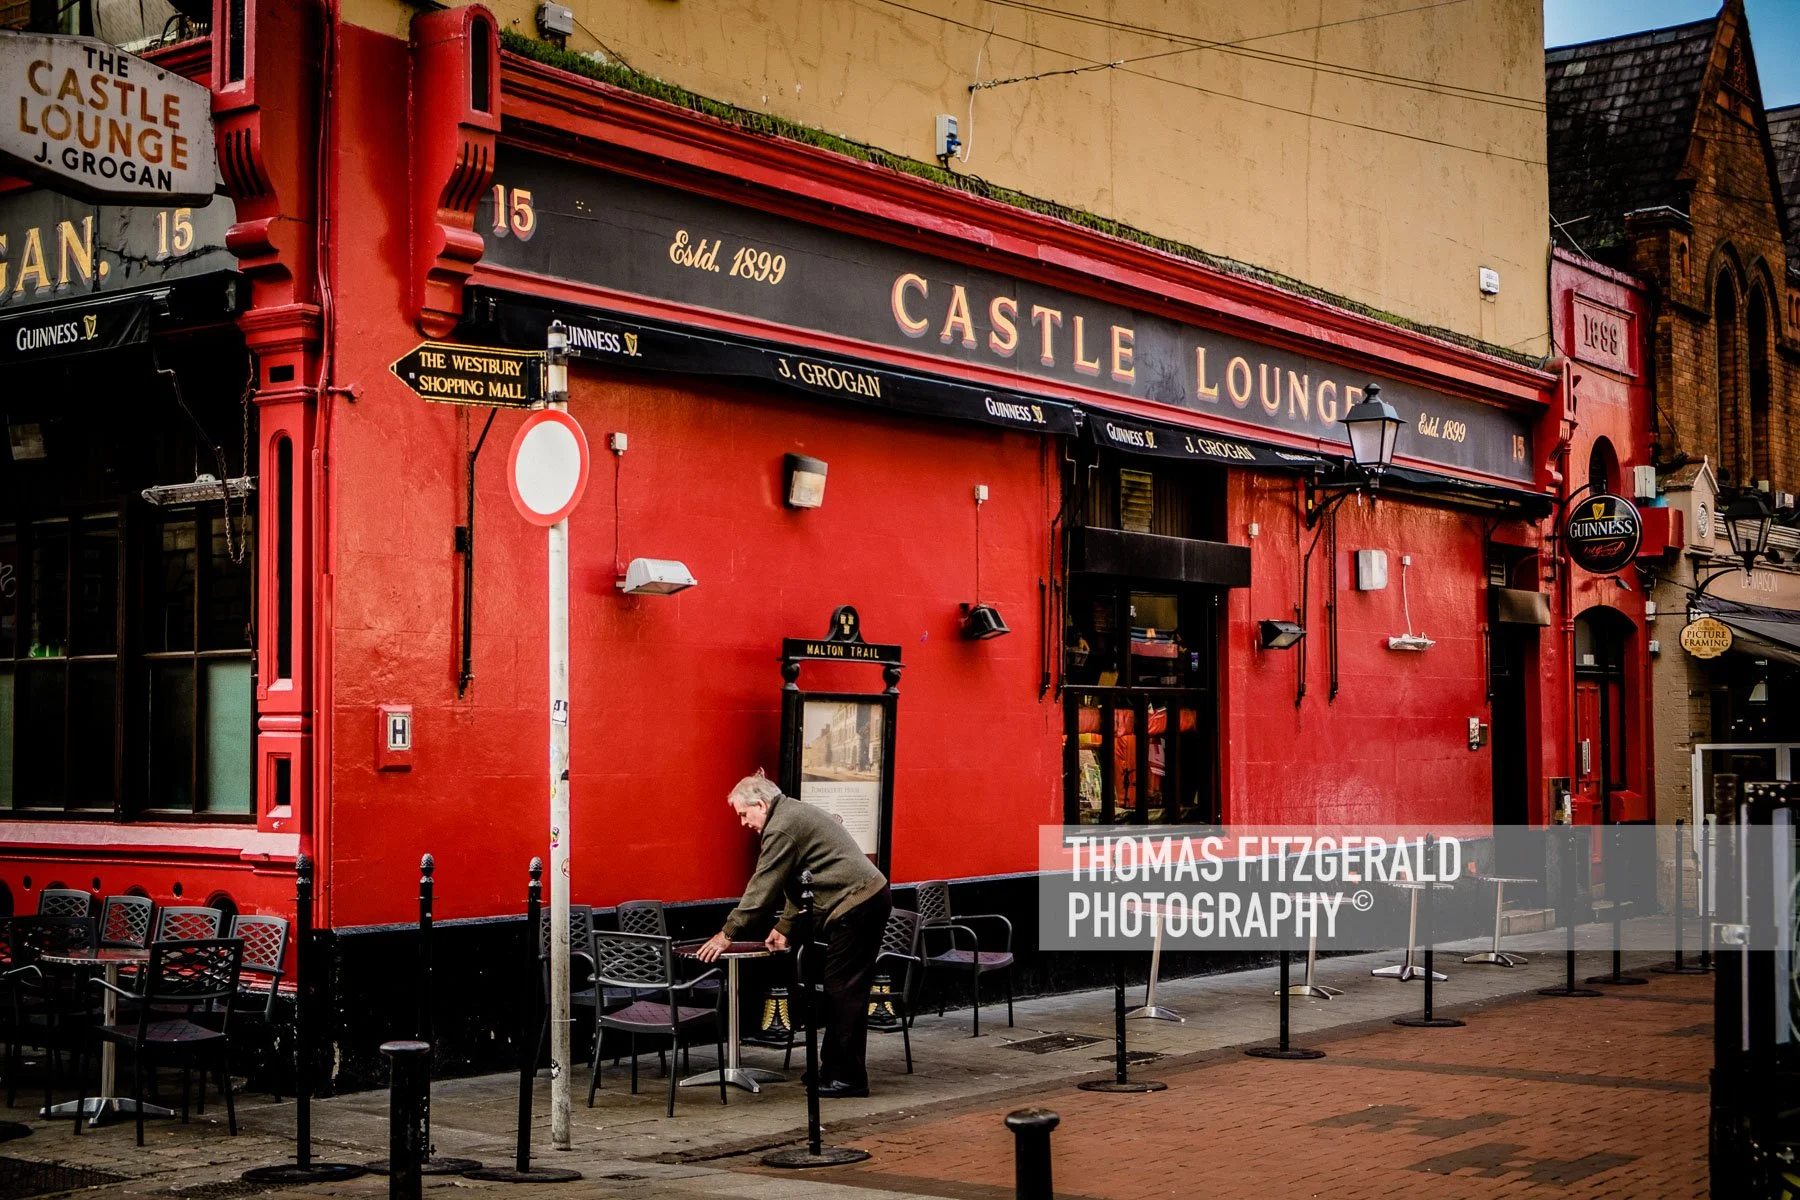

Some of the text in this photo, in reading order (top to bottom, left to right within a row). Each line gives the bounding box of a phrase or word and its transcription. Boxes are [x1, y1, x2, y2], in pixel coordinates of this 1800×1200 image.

[83, 46, 129, 78] THE
[27, 59, 181, 130] CASTLE
[19, 96, 188, 171] LOUNGE
[34, 141, 173, 193] J. GROGAN
[488, 183, 536, 242] 15
[156, 207, 193, 259] 15
[669, 230, 787, 285] Estd. 1899
[16, 322, 79, 351] GUINNESS
[892, 272, 1136, 384] CASTLE
[418, 351, 524, 377] THE WESTBURY
[779, 358, 881, 398] J. GROGAN
[418, 375, 527, 400] SHOPPING MALL
[985, 397, 1032, 422] GUINNESS
[1107, 422, 1145, 448] GUINNESS
[1418, 412, 1466, 443] Estd. 1899
[1185, 436, 1199, 454] J.
[1200, 438, 1256, 461] GROGAN
[1512, 434, 1525, 461] 15
[1569, 520, 1633, 539] GUINNESS
[1684, 639, 1729, 648] FRAMING
[1687, 630, 1727, 639] PICTURE
[806, 644, 880, 659] MALTON TRAIL
[392, 718, 406, 745] H
